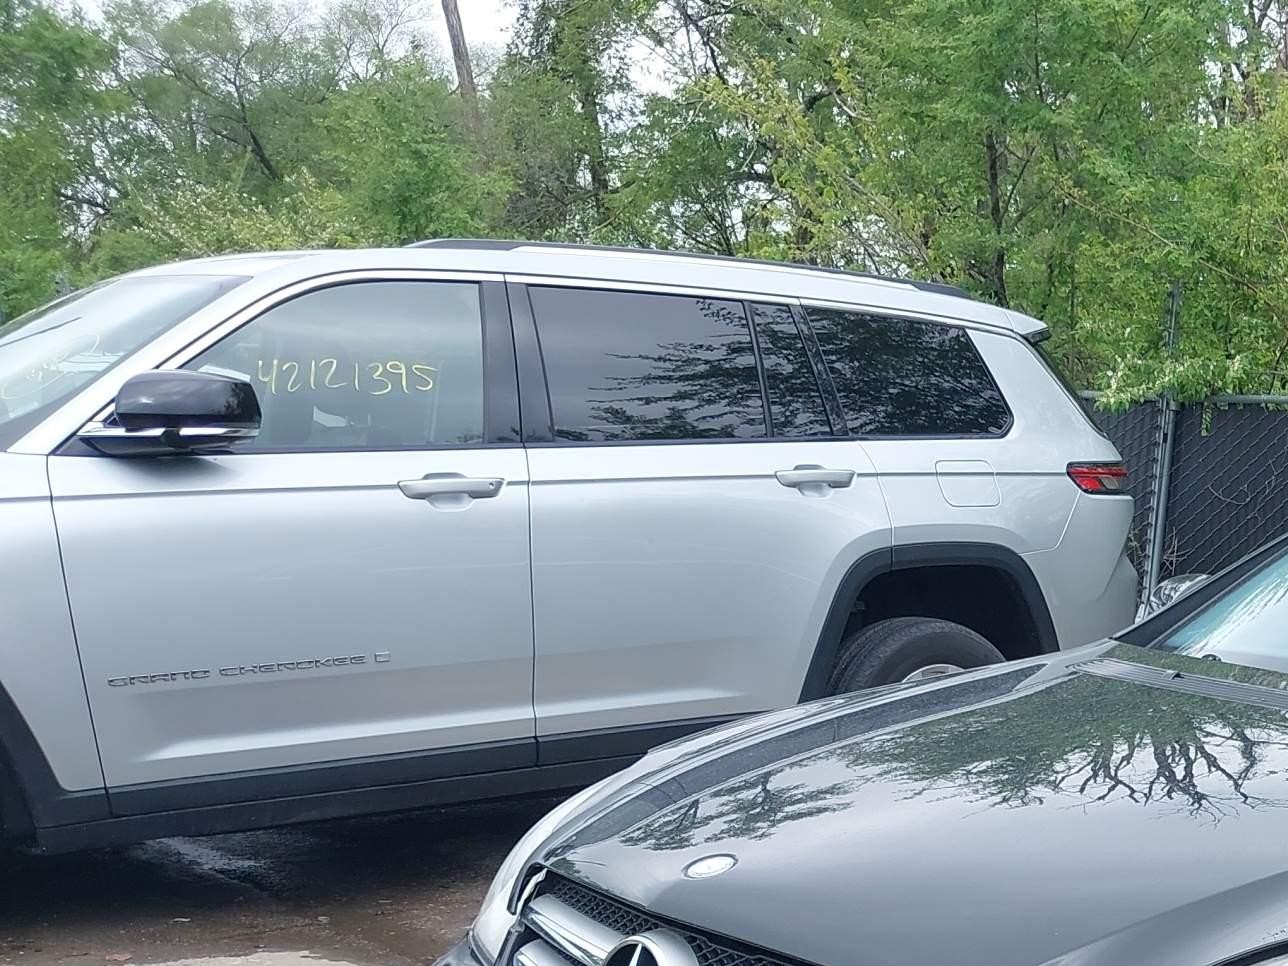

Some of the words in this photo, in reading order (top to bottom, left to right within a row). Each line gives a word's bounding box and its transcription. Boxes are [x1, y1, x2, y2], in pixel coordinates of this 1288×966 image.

[256, 358, 438, 395] 42121395
[107, 669, 210, 687] GRAND
[218, 654, 367, 677] CHEROKEE
